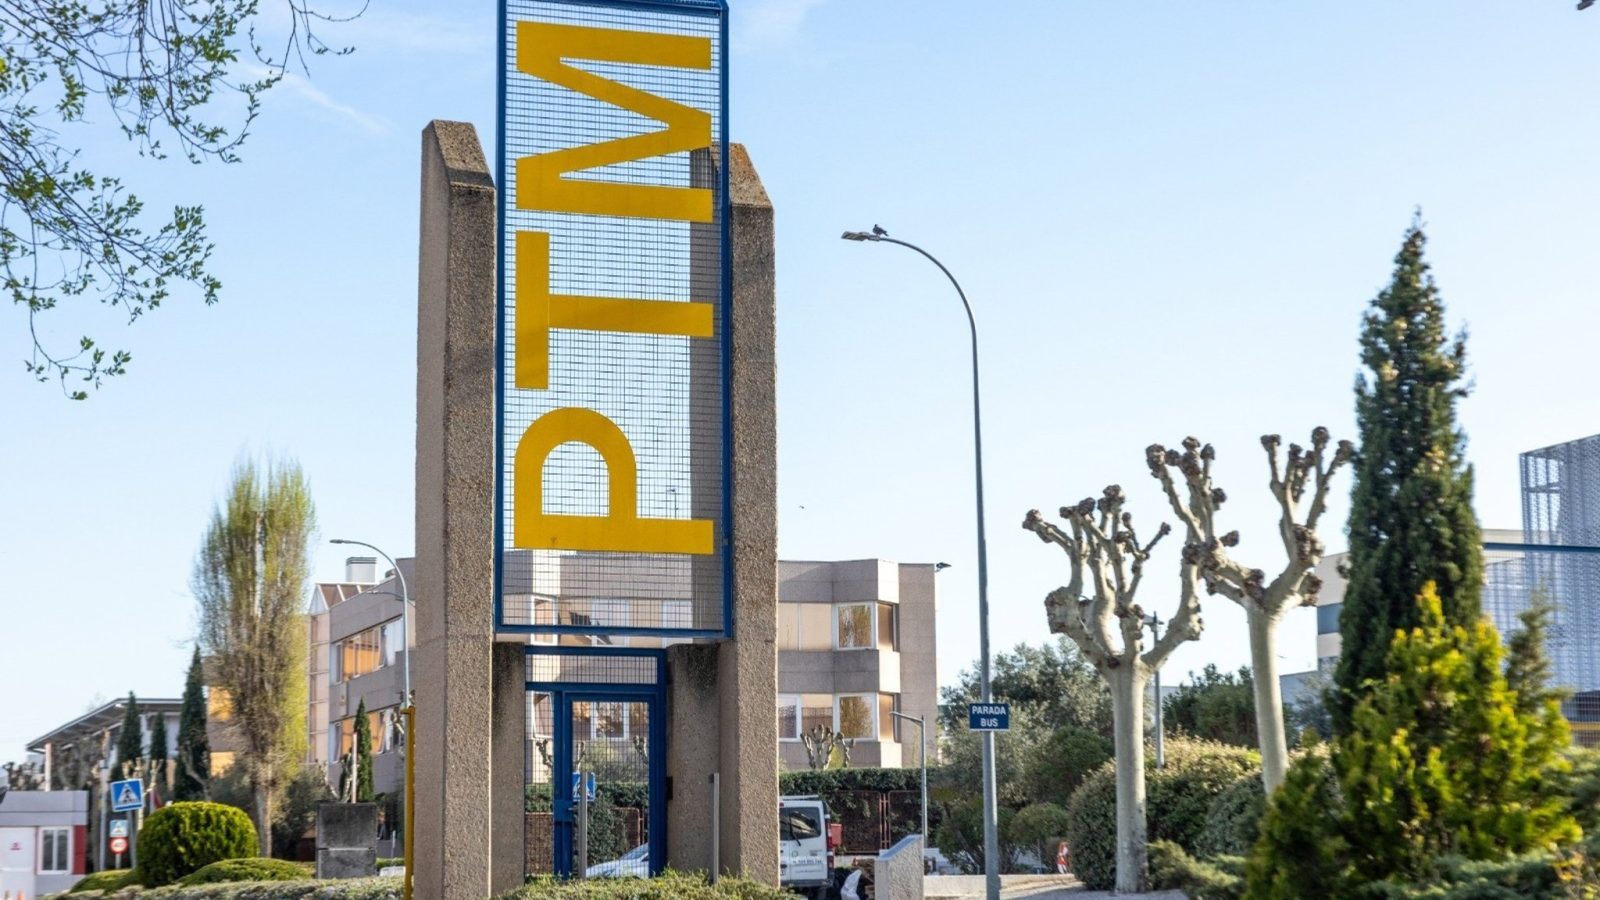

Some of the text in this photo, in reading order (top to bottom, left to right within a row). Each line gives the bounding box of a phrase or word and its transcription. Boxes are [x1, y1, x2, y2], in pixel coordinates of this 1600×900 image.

[514, 20, 714, 555] PTM
[972, 705, 1006, 715] PARADA
[981, 718, 998, 727] BUS
